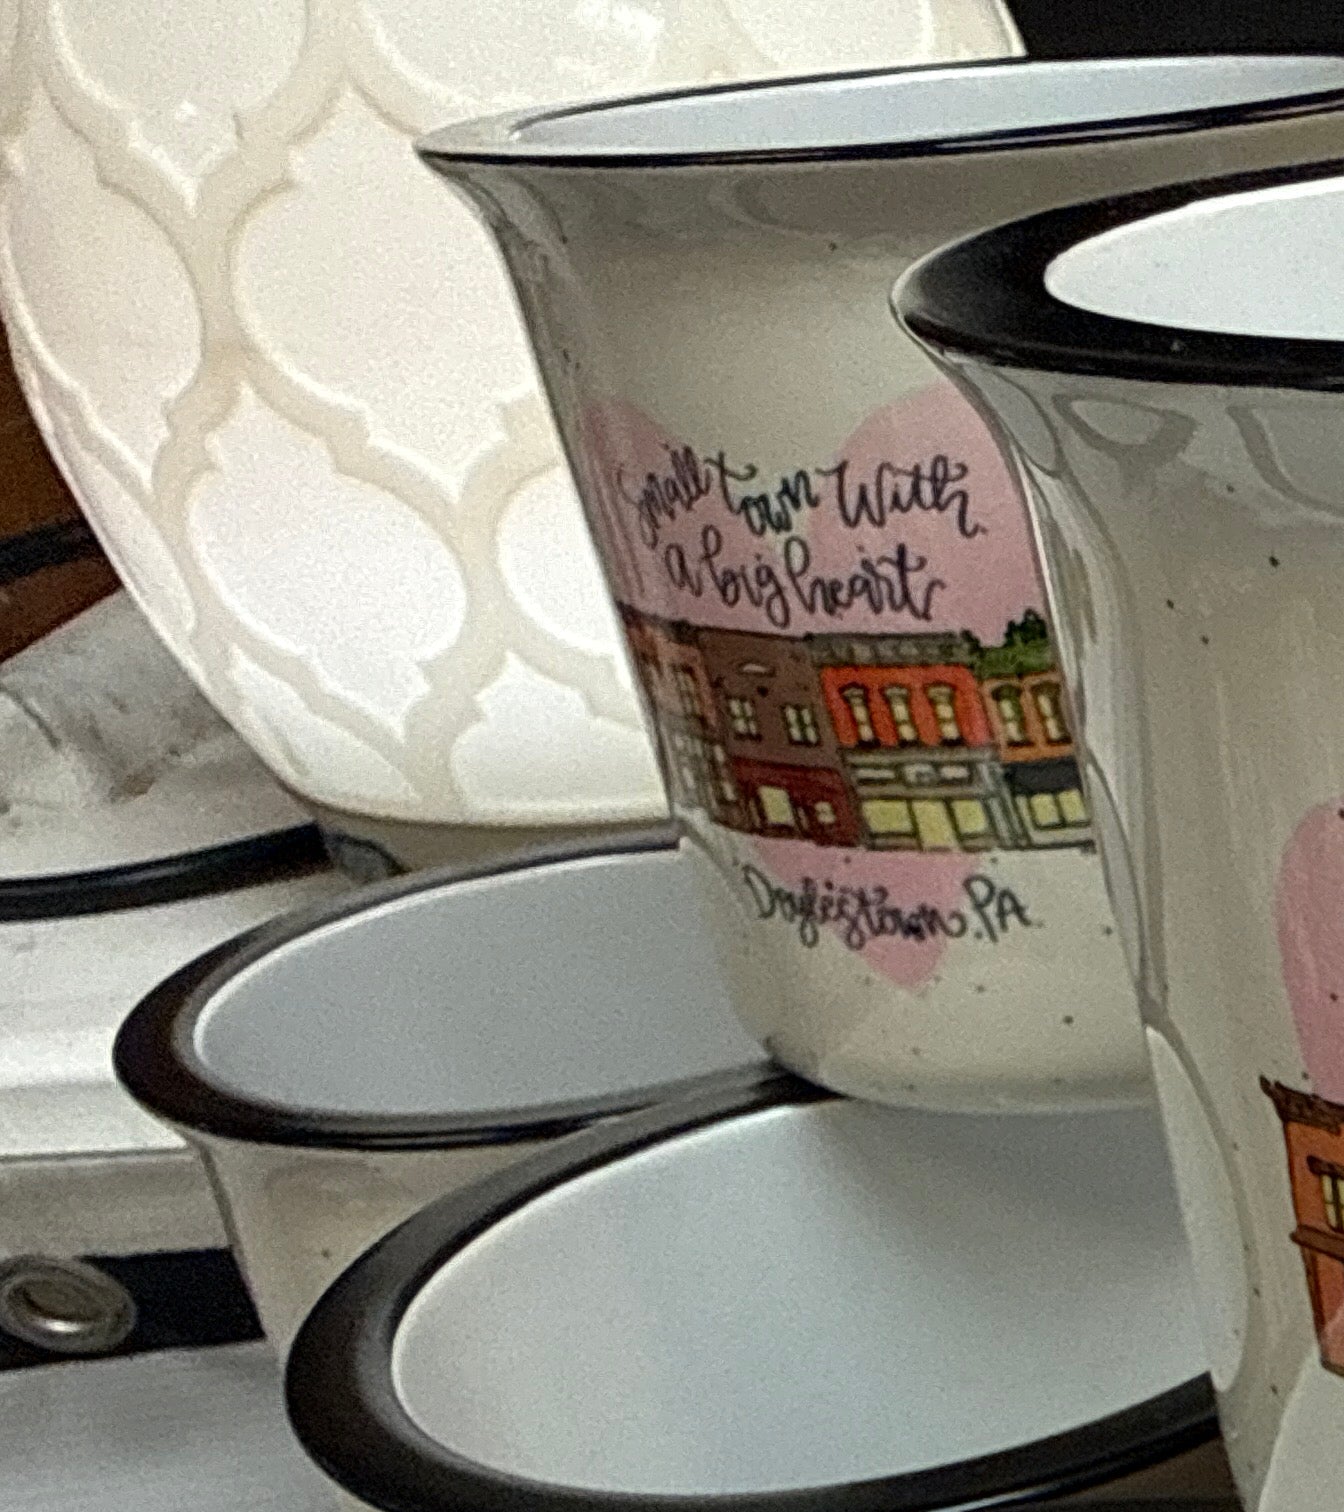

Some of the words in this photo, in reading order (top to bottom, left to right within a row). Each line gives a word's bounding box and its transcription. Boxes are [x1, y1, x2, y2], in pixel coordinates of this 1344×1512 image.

[617, 446, 714, 549] Small
[704, 450, 819, 537] town
[701, 524, 791, 629] big
[784, 535, 947, 620] heart
